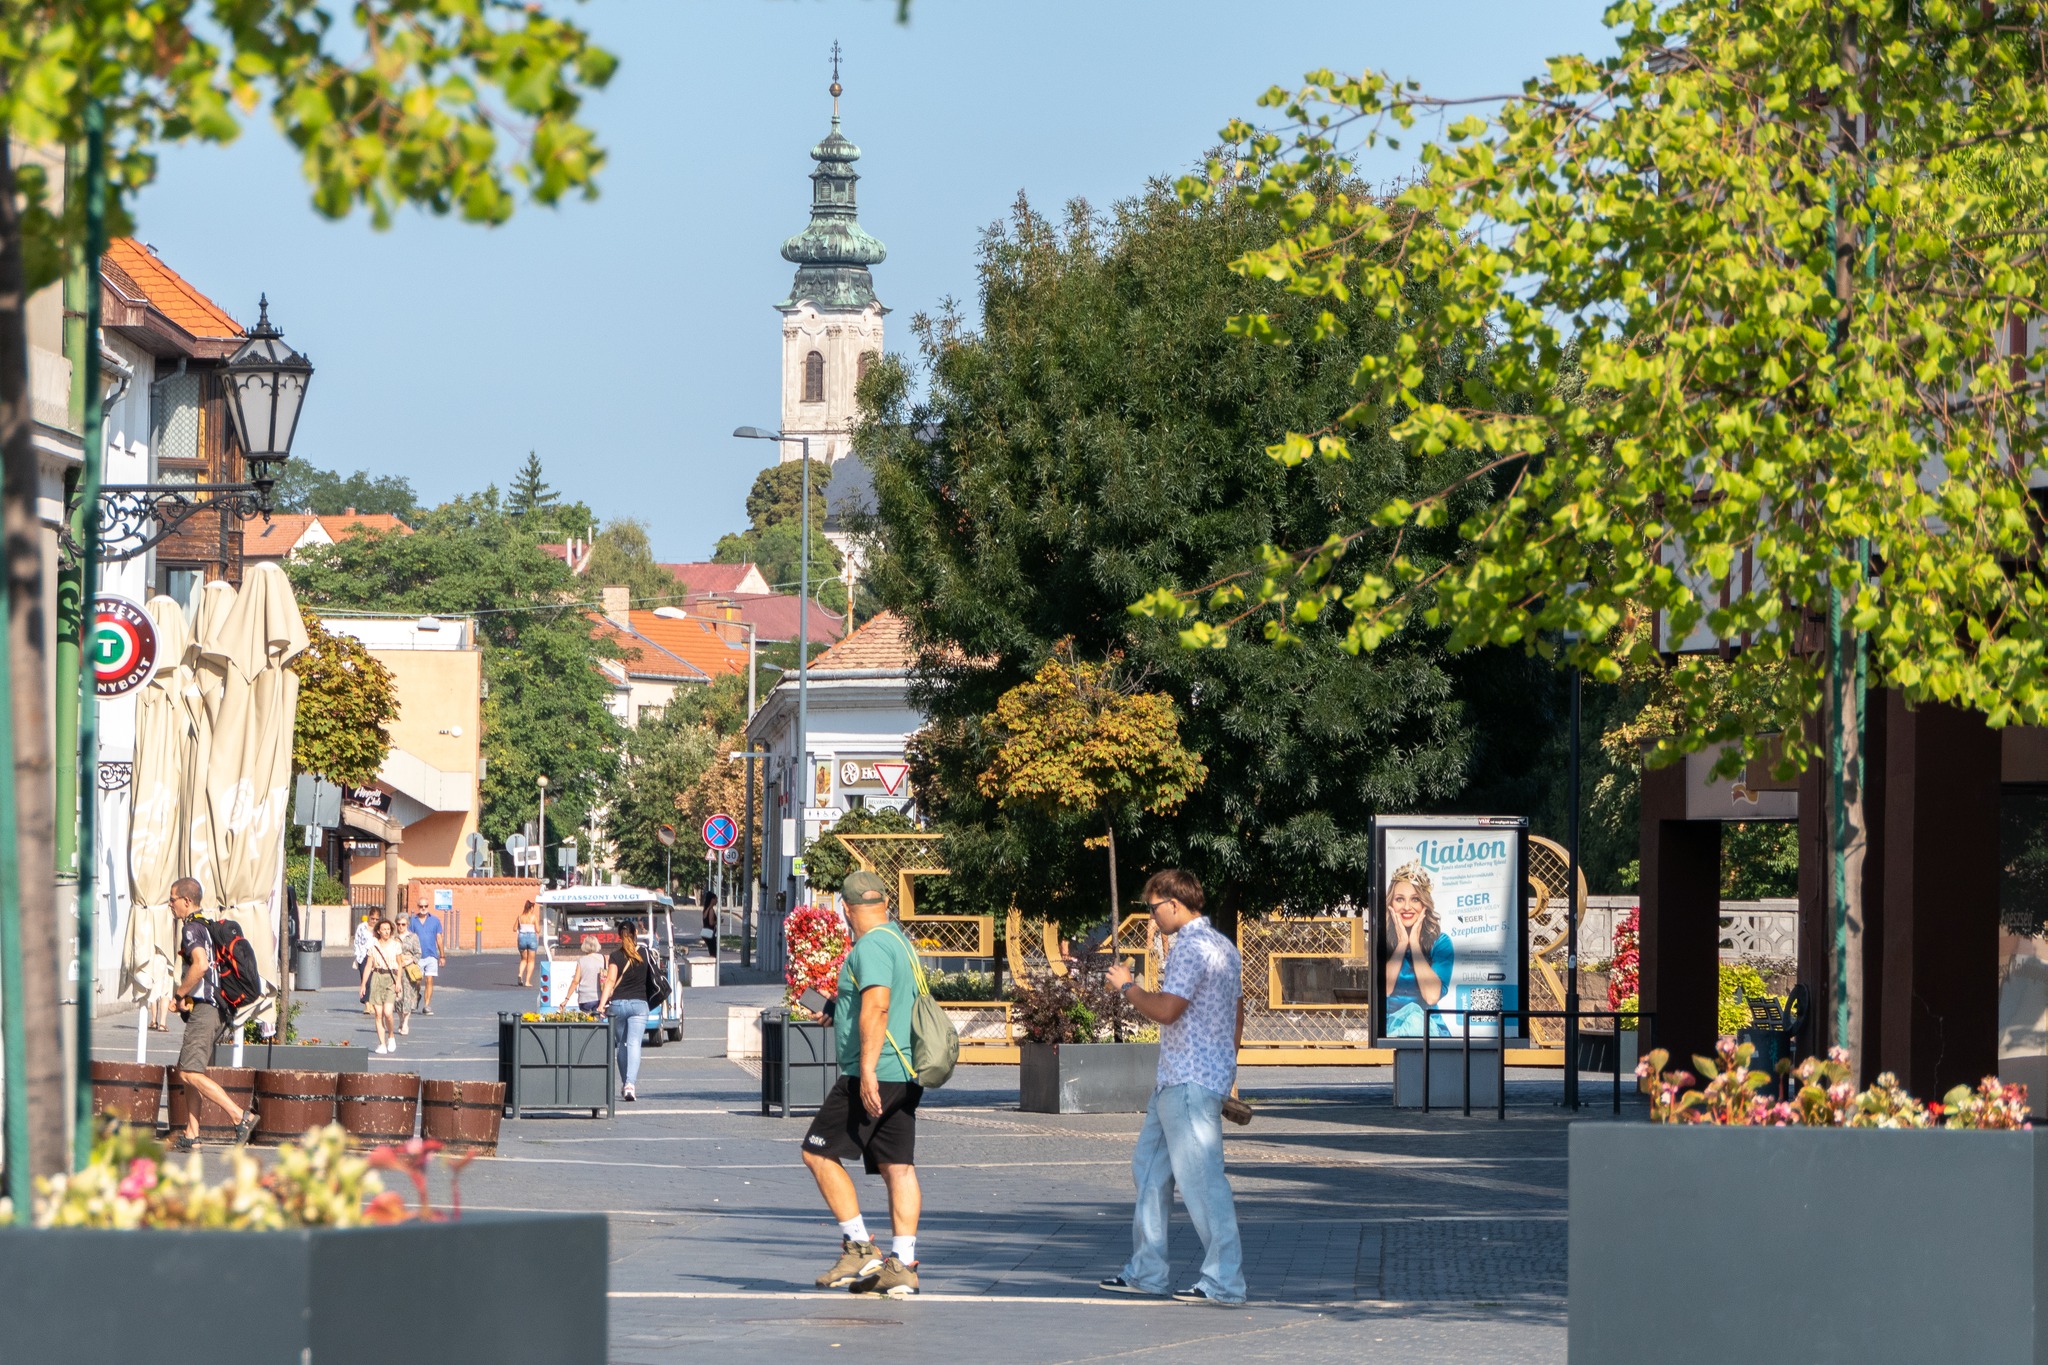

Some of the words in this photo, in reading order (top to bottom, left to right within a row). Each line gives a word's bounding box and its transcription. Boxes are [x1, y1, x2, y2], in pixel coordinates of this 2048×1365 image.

[97, 638, 117, 658] T
[97, 656, 151, 693] NYBOLT
[365, 796, 382, 807] Club
[1416, 837, 1507, 873] Liaison
[1457, 892, 1490, 908] EGER
[1464, 914, 1484, 923] EGER
[1451, 923, 1500, 938] Szeptember
